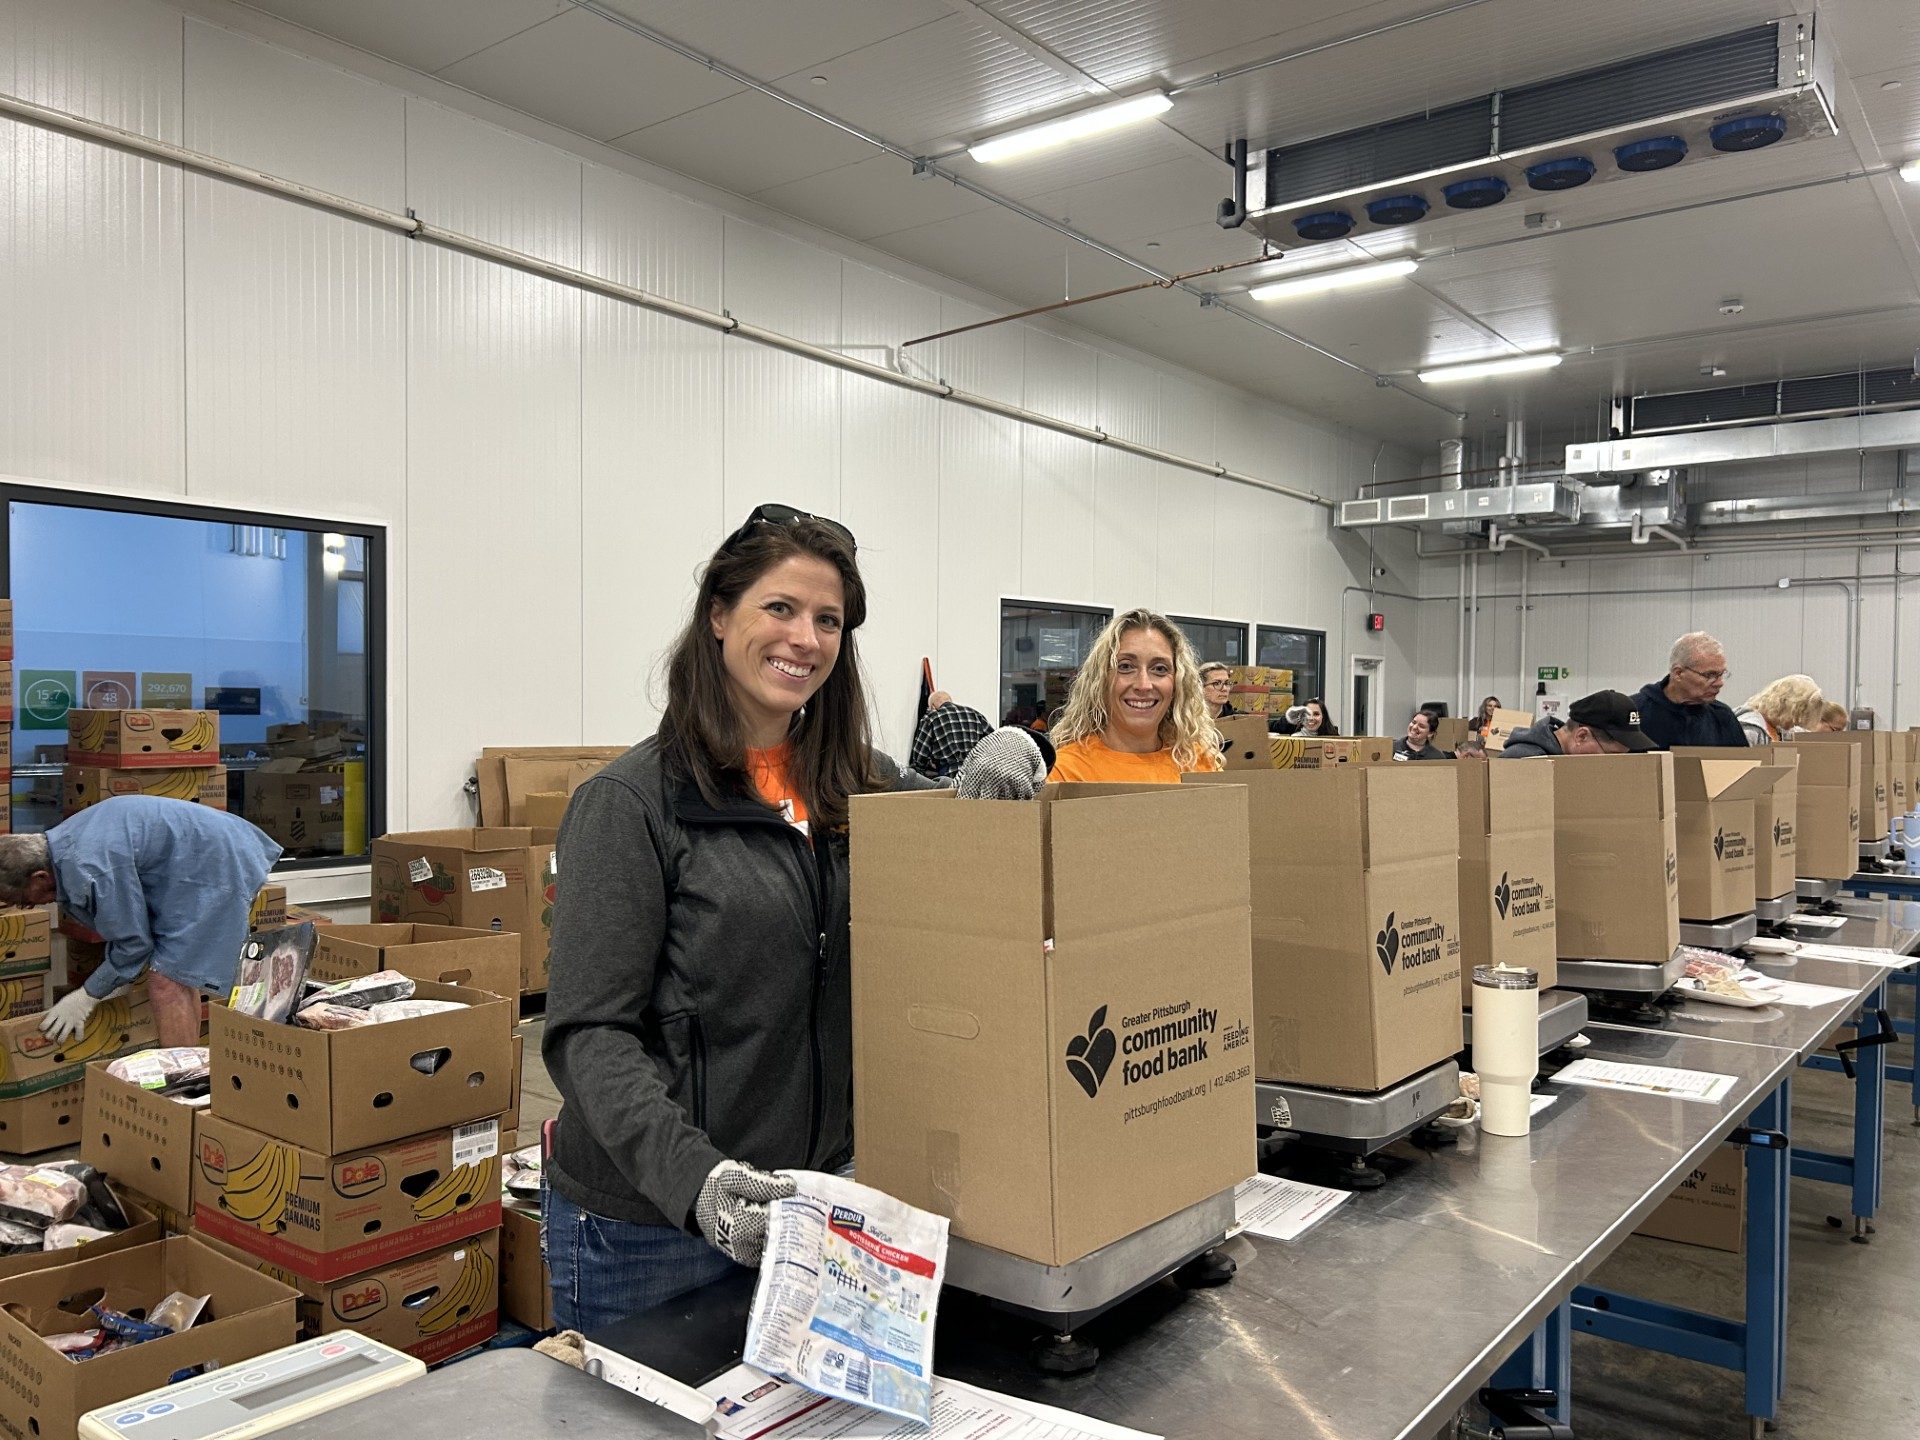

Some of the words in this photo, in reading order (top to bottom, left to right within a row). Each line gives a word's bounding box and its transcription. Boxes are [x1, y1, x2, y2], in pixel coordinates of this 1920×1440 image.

[102, 693, 117, 702] 48
[147, 683, 186, 693] 292,670
[1511, 882, 1543, 901] community
[1512, 903, 1525, 917] food
[1526, 898, 1540, 914] bank
[1401, 922, 1445, 949] community
[1402, 948, 1421, 970] food
[1421, 943, 1441, 964] bank
[1121, 1013, 1152, 1028] Greater
[1152, 1000, 1191, 1020] Pittsburgh
[1121, 1008, 1218, 1055] community
[1222, 1035, 1250, 1052] AMERICA
[1122, 1049, 1164, 1086] food
[1167, 1037, 1208, 1071] bank
[1123, 1083, 1207, 1125] pittsburghfoodbank.org
[1213, 1065, 1251, 1088] 412.460.3663
[342, 1162, 380, 1185] Dole
[285, 1190, 321, 1216] PREMIUM
[833, 1207, 863, 1224] PERDUE
[284, 1207, 321, 1232] BANANAS
[343, 1243, 379, 1261] PREMIUM
[379, 1233, 414, 1250] BANANAS
[422, 1220, 455, 1236] PREMIUM
[455, 1209, 487, 1227] BANANAS
[849, 1229, 880, 1253] ROTISSERIE
[881, 1247, 909, 1263] CHICKEN
[342, 1286, 381, 1309] Dole
[422, 1333, 455, 1353] PREMIUM
[455, 1321, 487, 1341] BANANAS
